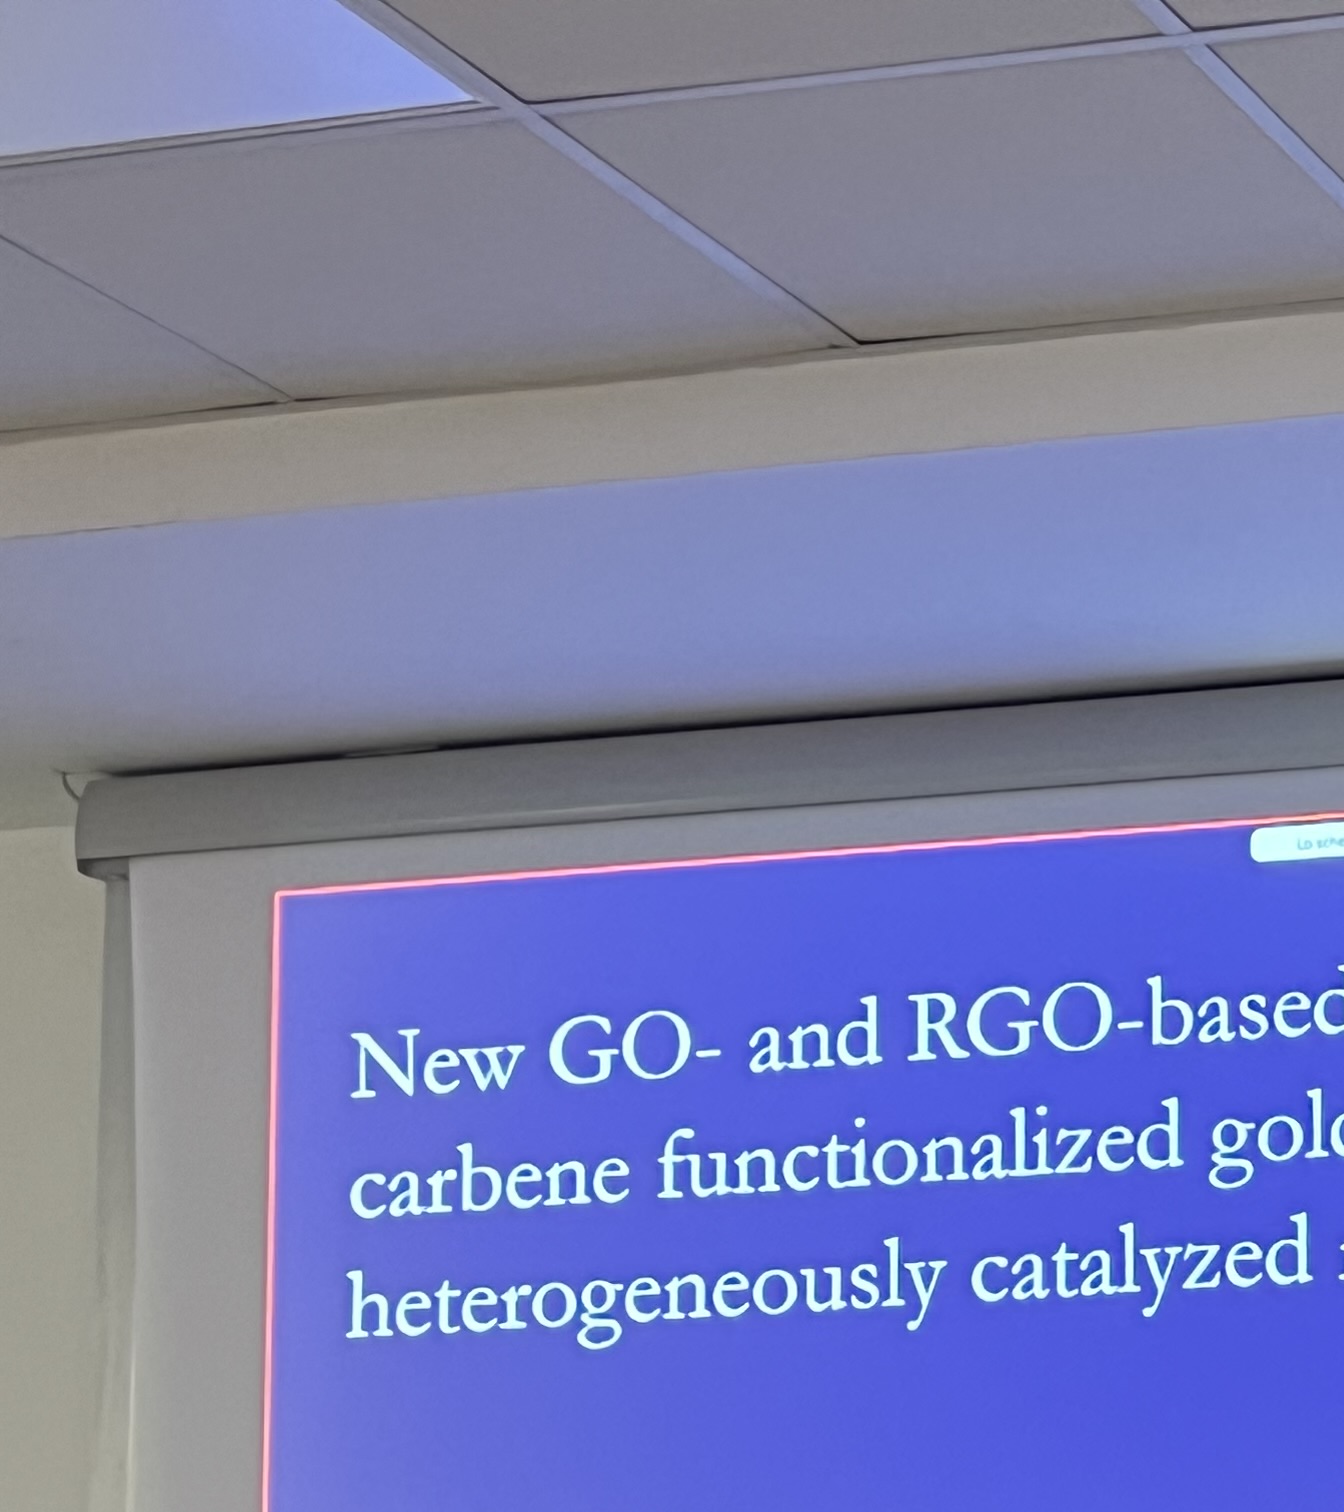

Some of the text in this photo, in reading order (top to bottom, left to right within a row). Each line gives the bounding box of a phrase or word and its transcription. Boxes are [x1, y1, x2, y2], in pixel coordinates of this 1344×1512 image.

[351, 1029, 525, 1098] New
[549, 1011, 721, 1084] GO-
[749, 995, 882, 1073] and
[350, 1143, 629, 1219] carbene
[657, 1097, 1184, 1198] functionalized
[346, 1237, 947, 1350] heterogeneously
[971, 1211, 1313, 1317] catalyzed
